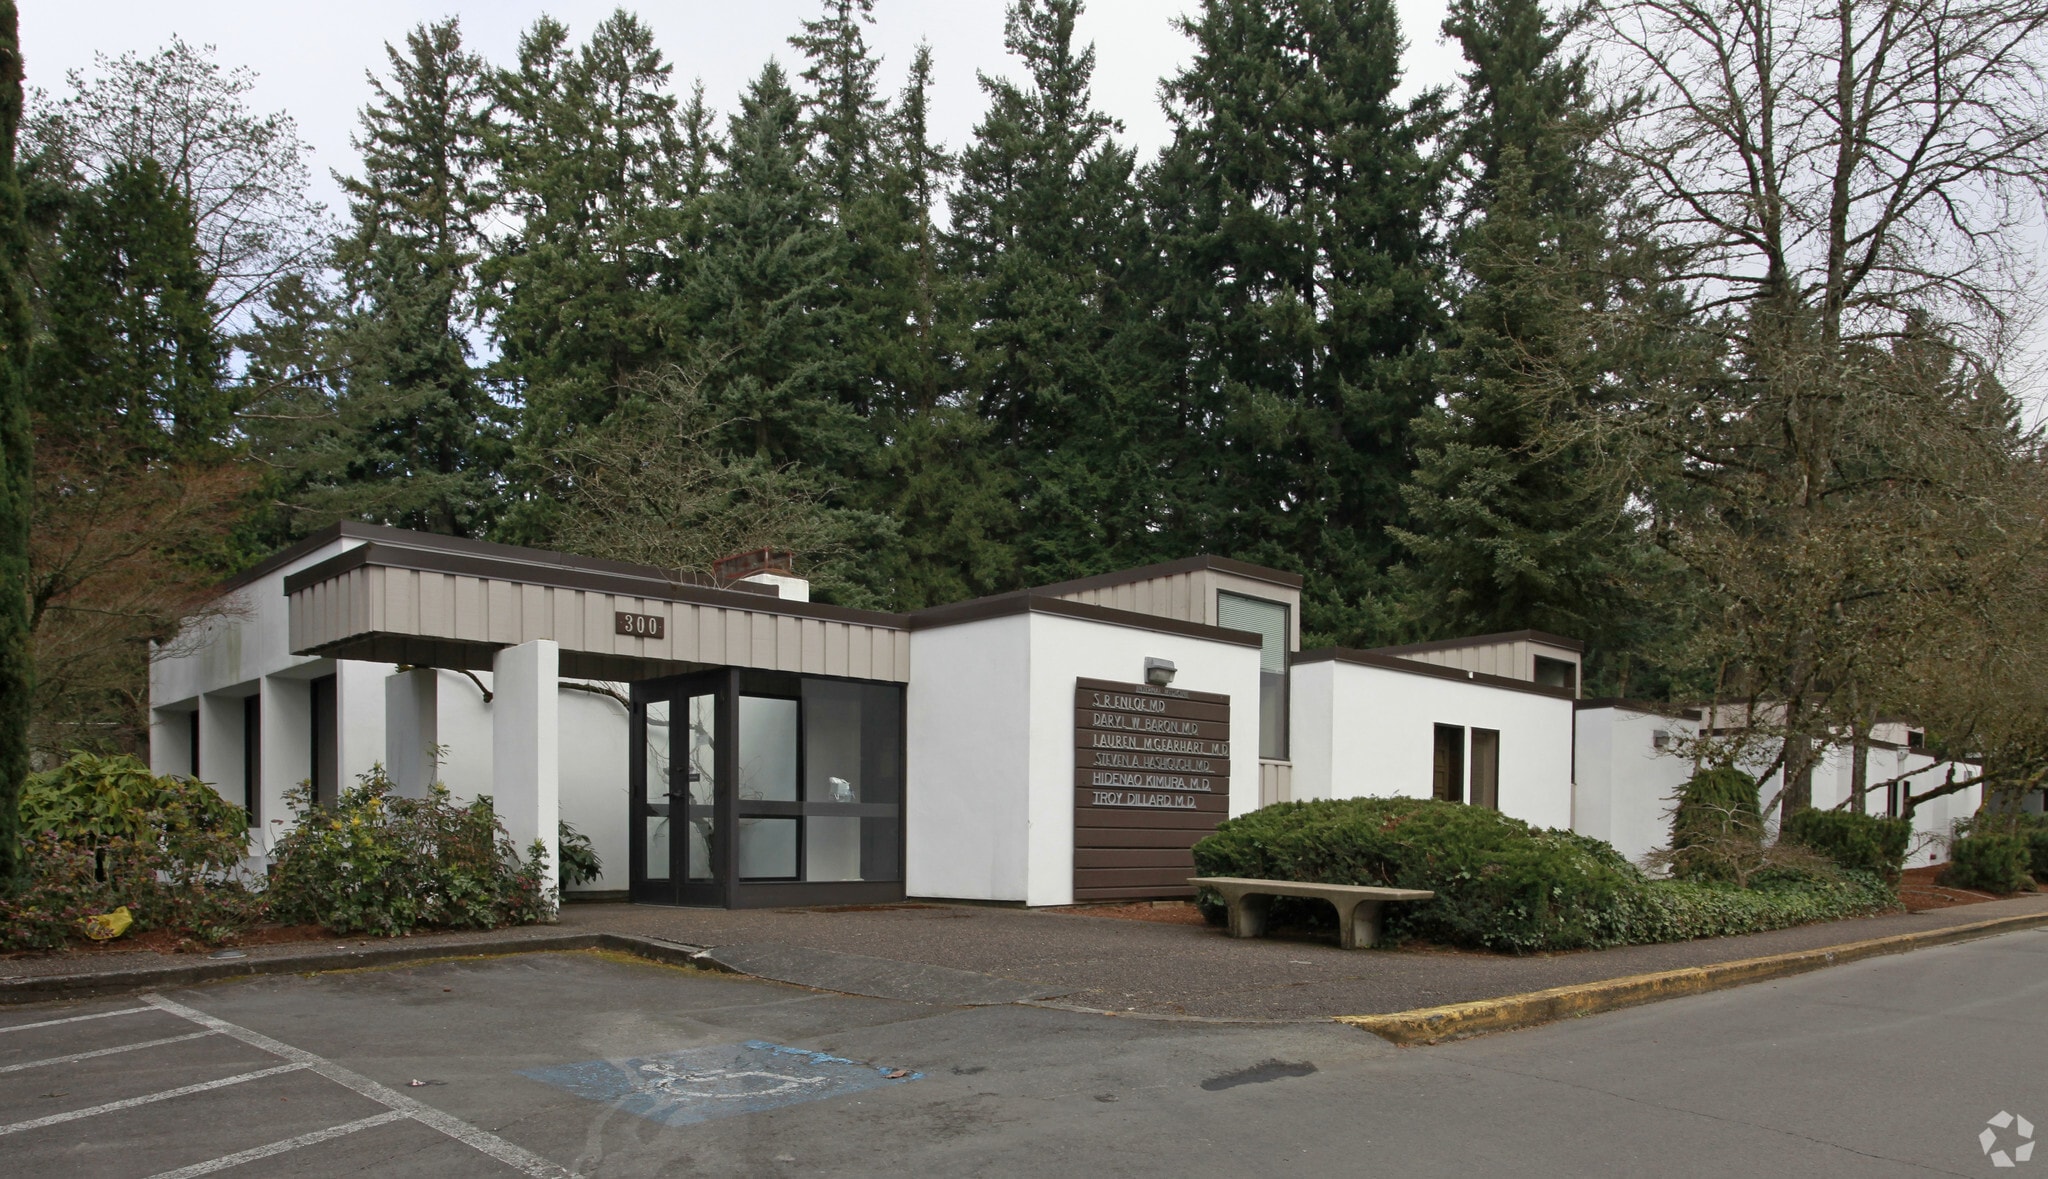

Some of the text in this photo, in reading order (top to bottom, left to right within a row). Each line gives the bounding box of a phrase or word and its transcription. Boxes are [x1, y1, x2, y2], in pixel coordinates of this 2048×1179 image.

[625, 614, 657, 635] 300
[1093, 713, 1126, 728] DARYL
[1145, 718, 1178, 733] BARON
[1093, 734, 1137, 749] LAUREN
[1094, 752, 1129, 767] STEVEN
[1093, 772, 1142, 786] HIDENAO
[1093, 791, 1123, 805] TROY
